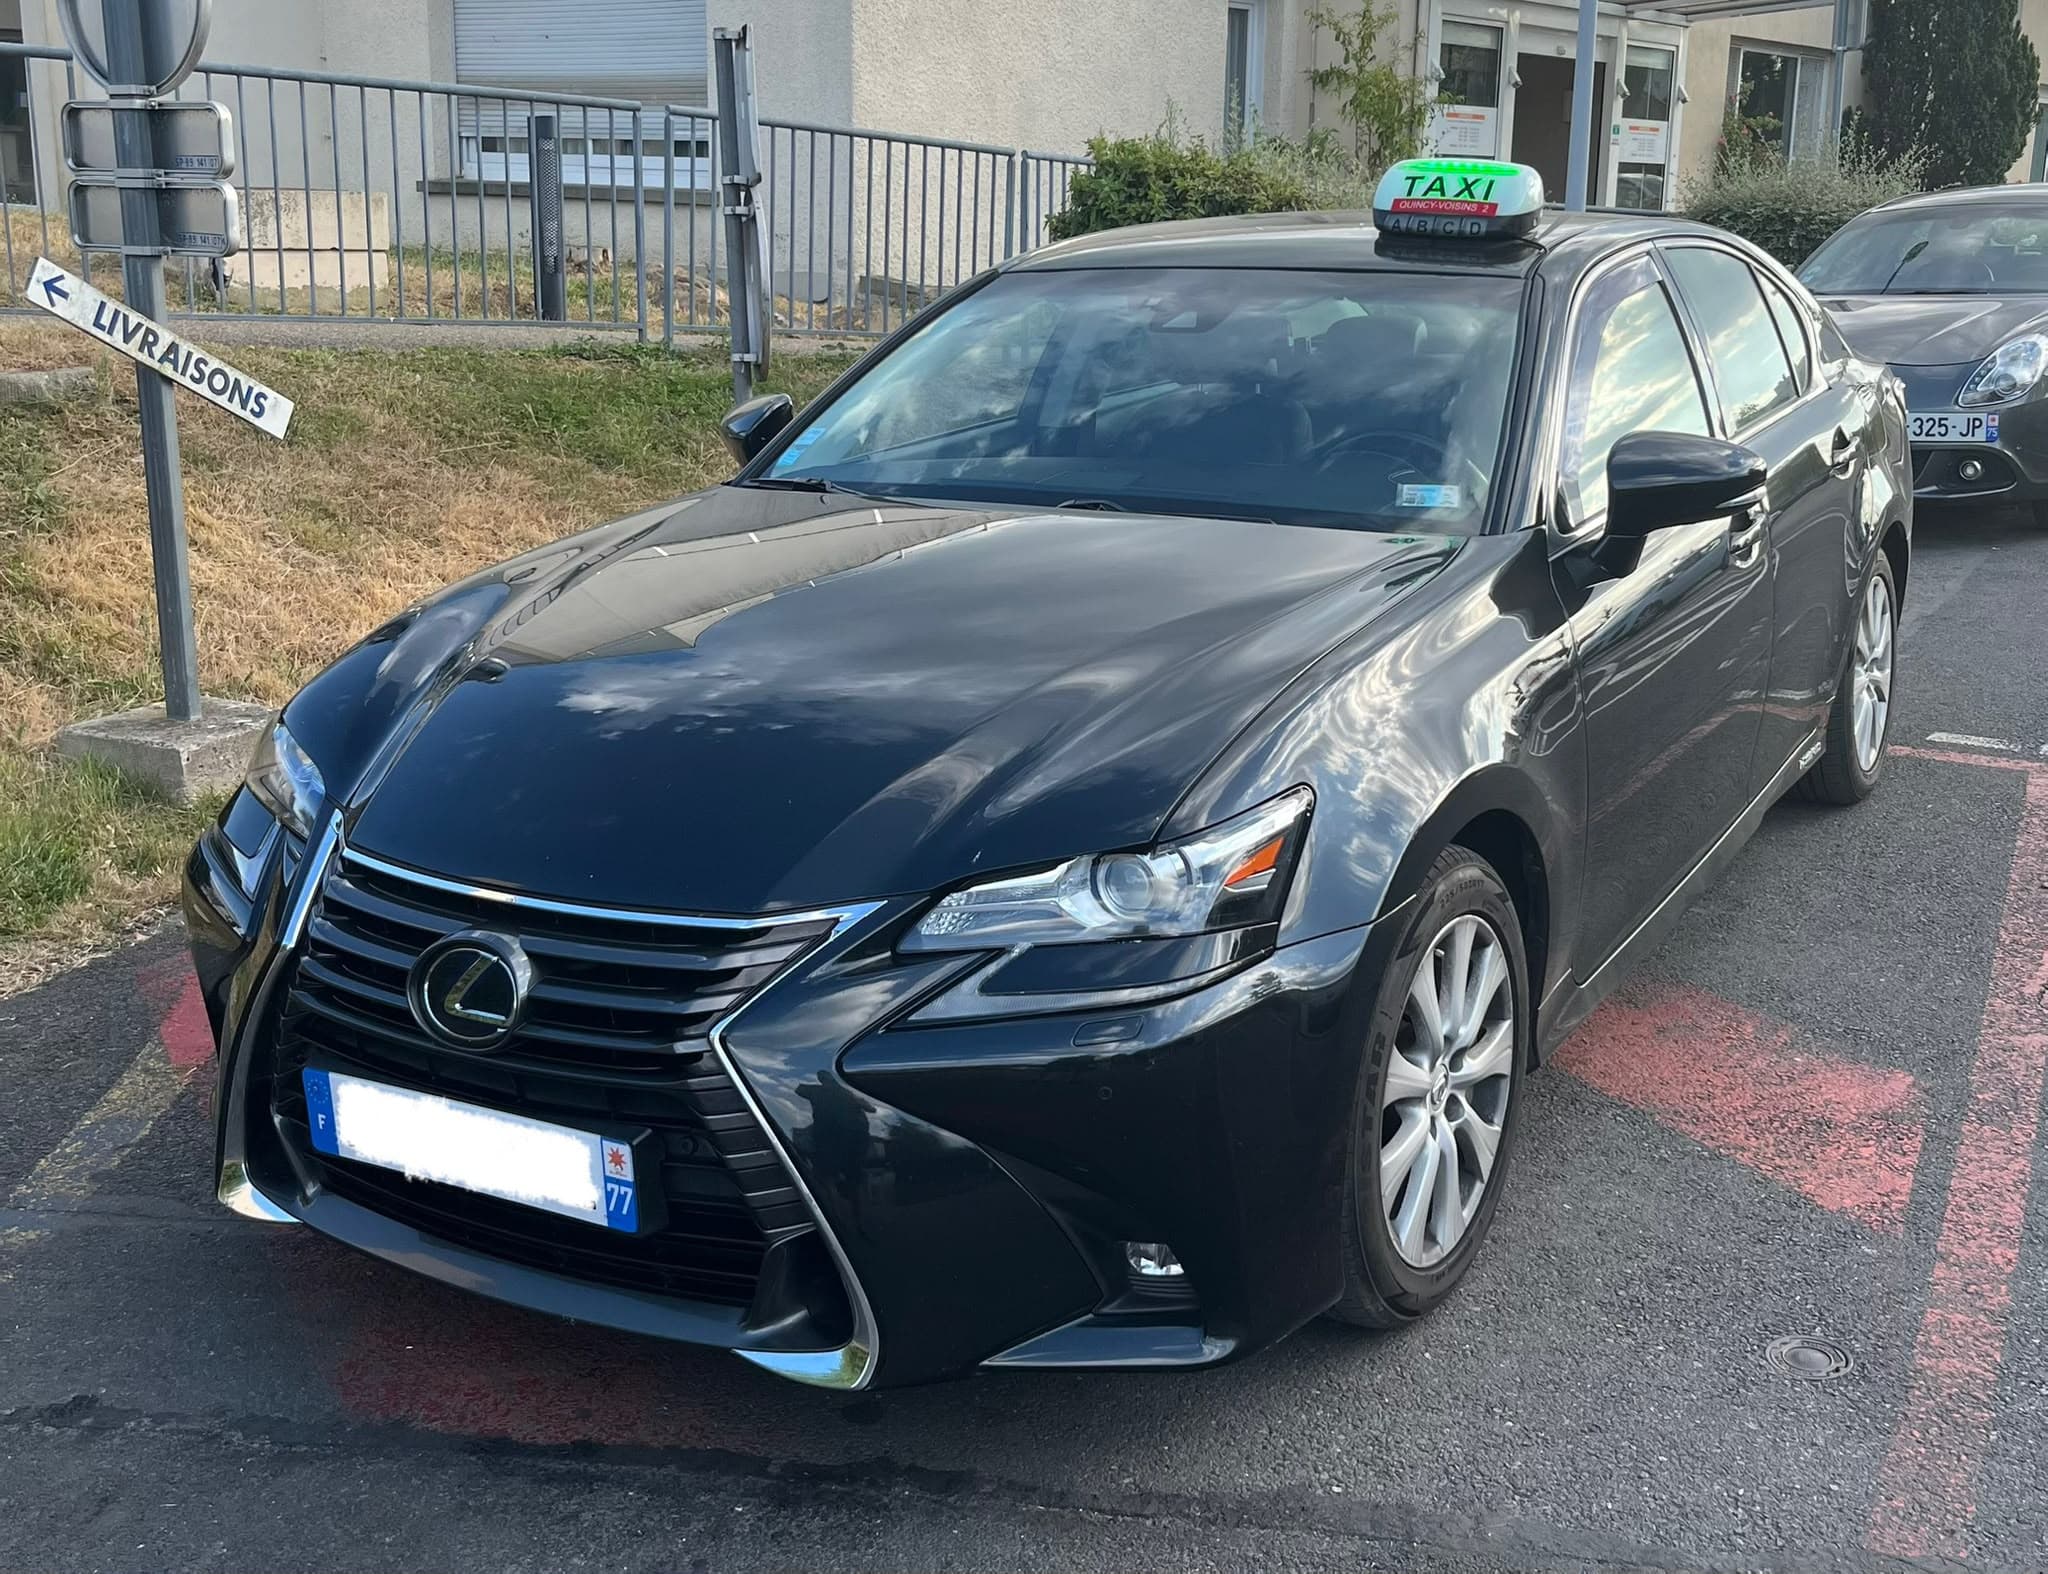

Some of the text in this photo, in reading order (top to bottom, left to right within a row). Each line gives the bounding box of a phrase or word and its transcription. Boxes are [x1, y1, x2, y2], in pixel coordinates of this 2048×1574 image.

[1404, 175, 1495, 201] TAXI
[1399, 201, 1489, 213] QUINCY-VOISINS 2
[1391, 219, 1481, 235] A B C D
[92, 300, 269, 419] LIVRAISONS
[1987, 427, 1998, 437] 75
[317, 1113, 326, 1130] F
[606, 1182, 633, 1216] 77
